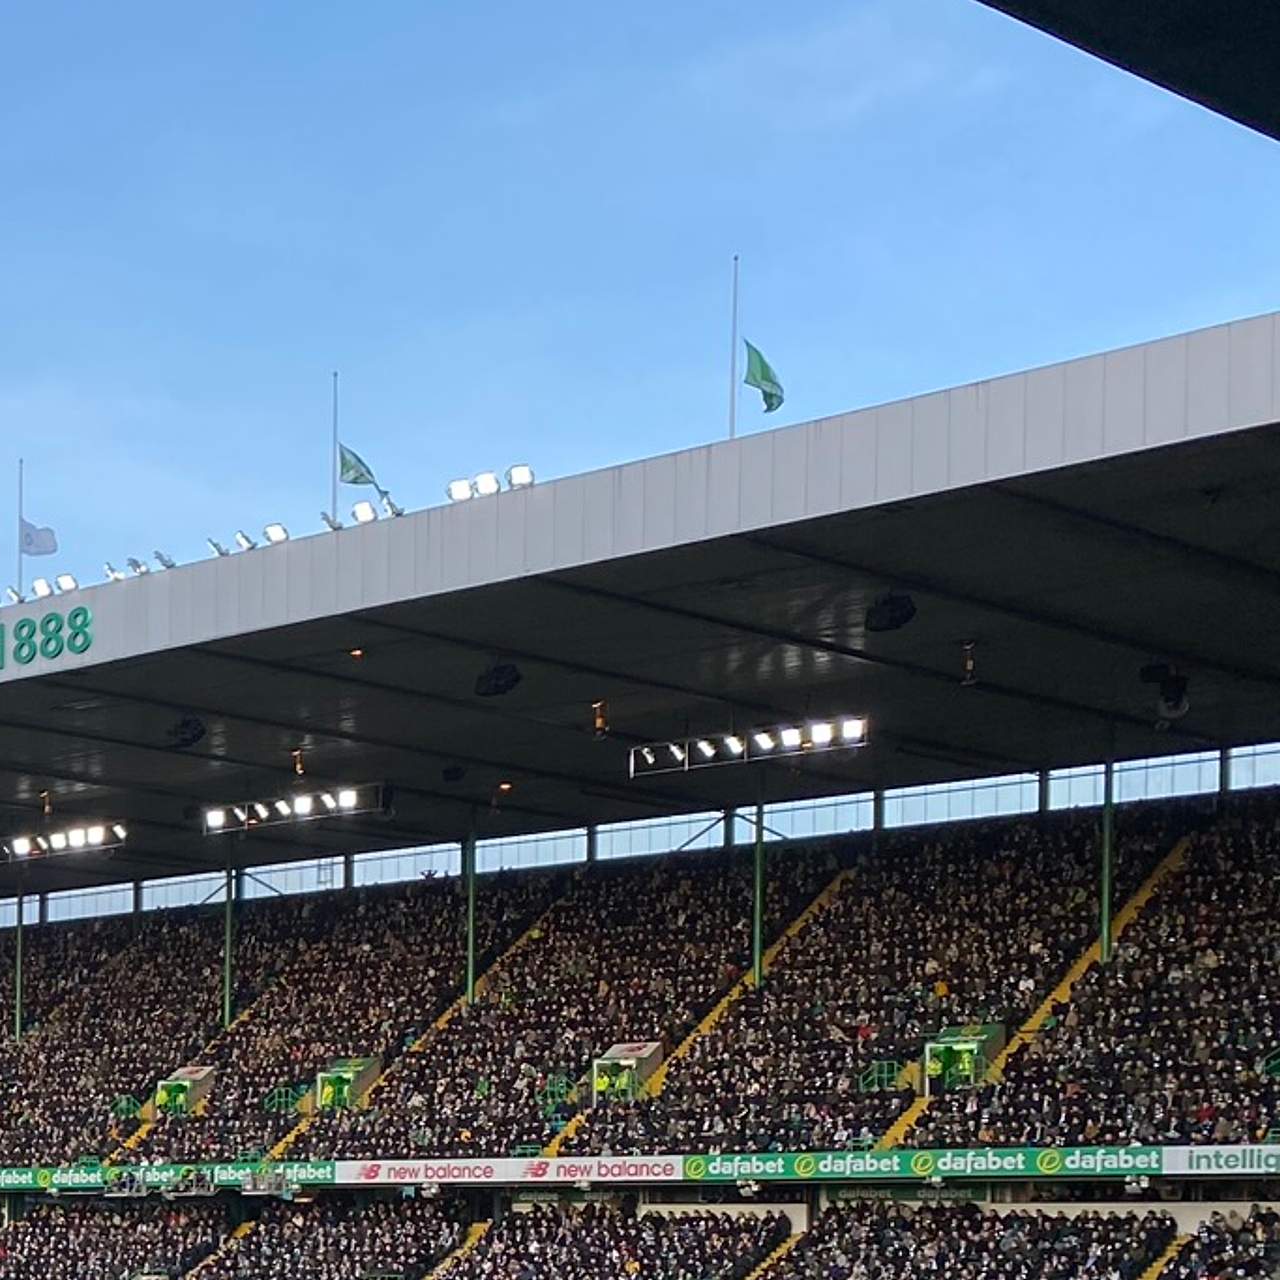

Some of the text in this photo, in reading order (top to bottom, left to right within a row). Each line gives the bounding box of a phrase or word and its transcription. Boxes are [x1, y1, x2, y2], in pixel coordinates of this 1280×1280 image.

[556, 1164, 594, 1177] new
[598, 1160, 675, 1177] balance
[709, 1157, 786, 1177] dafabet
[819, 1154, 900, 1175] dafabet
[937, 1150, 1026, 1174] dafabet
[1065, 1148, 1160, 1172] dafabet
[52, 1168, 102, 1184] dafabet
[387, 1167, 421, 1179] new
[425, 1163, 495, 1180] balance
